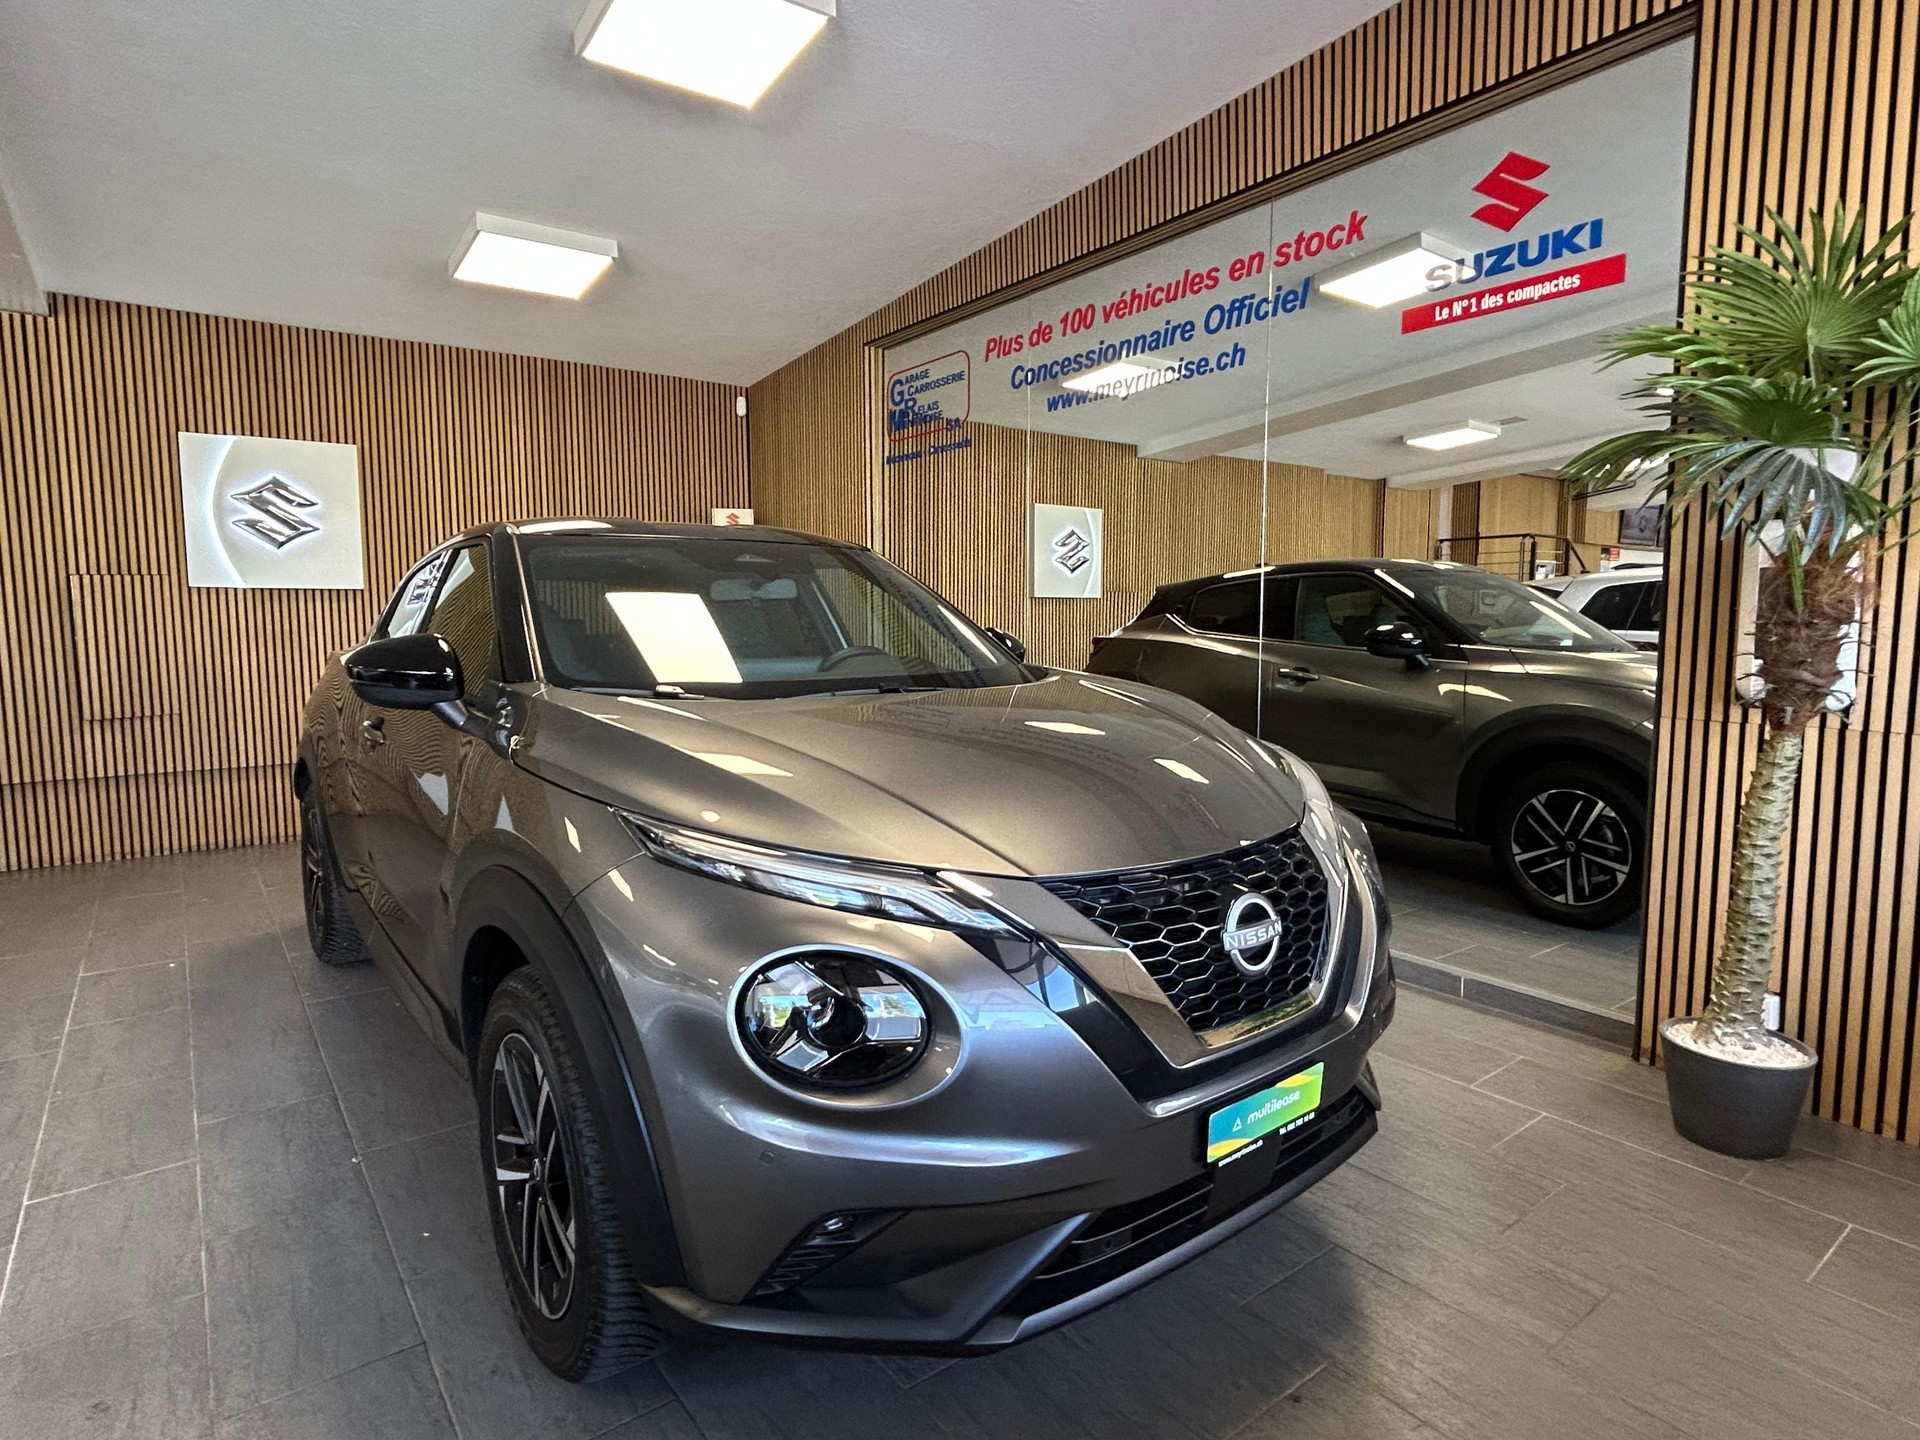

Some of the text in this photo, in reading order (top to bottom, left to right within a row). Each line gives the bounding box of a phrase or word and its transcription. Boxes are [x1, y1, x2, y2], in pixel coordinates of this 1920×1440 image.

[1425, 218, 1603, 291] SUZUKI
[984, 210, 1368, 362] Plus de 100 véhicules en stock
[1435, 306, 1448, 321] Le
[1481, 293, 1504, 310] des
[1507, 274, 1581, 304] compactes
[1011, 277, 1311, 389] Concessionnaire Officiel
[907, 370, 965, 397] CARROSSERIE
[1047, 343, 1246, 412] www.meyrinoise.ch
[1226, 920, 1282, 948] NISSAN
[1246, 1090, 1301, 1125] multilease
